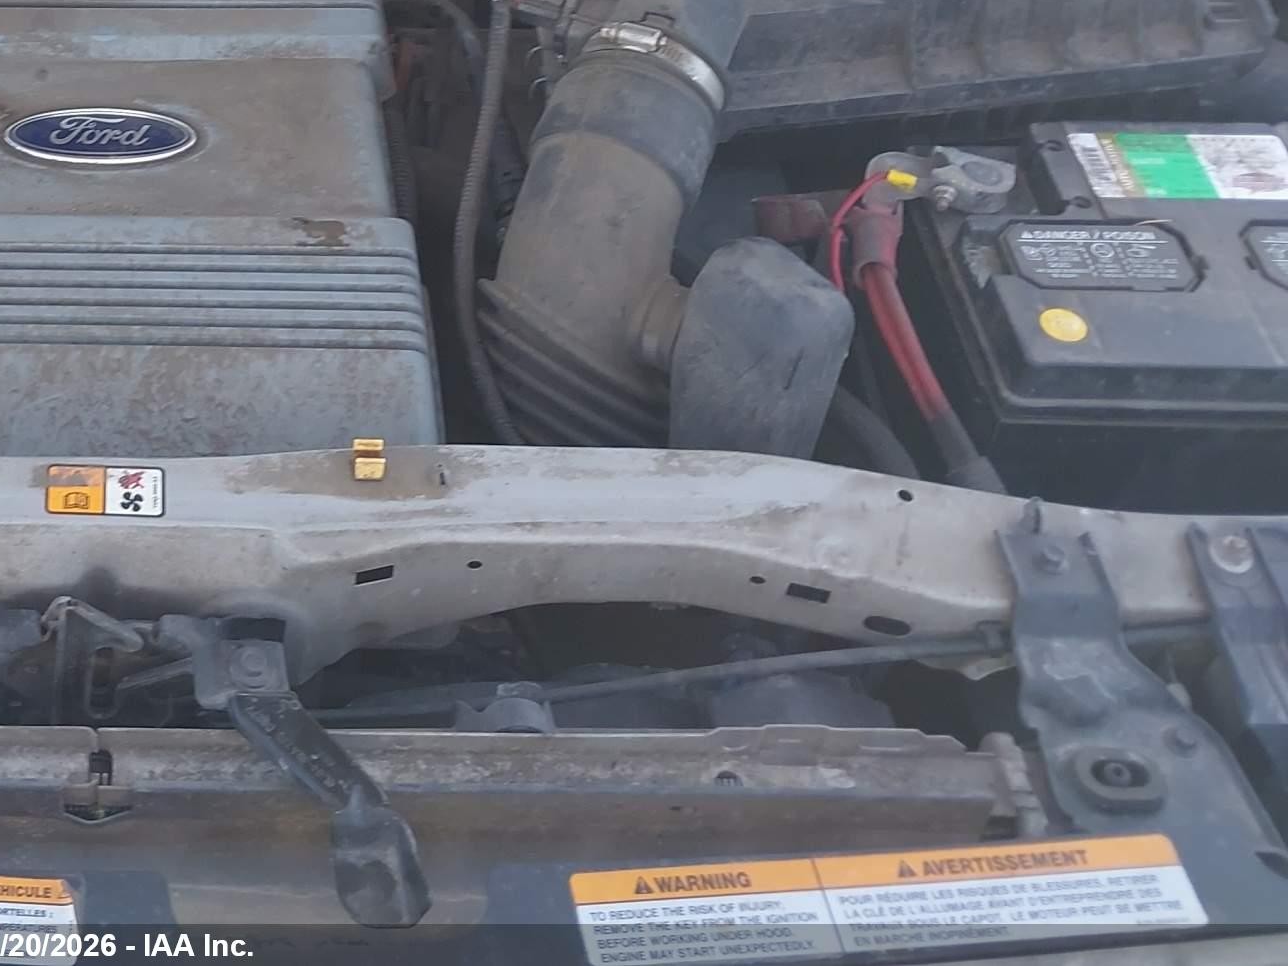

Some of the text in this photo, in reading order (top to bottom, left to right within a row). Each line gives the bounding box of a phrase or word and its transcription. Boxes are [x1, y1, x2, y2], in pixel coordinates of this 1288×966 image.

[50, 116, 152, 146] Ford
[923, 849, 1088, 876] AVERTISSEMENT
[655, 872, 751, 893] WARNING
[589, 912, 606, 921] TO
[611, 908, 658, 920] REDUCE
[662, 906, 685, 916] THE
[688, 904, 715, 915] RISK
[720, 903, 736, 913] OF
[593, 912, 818, 934] REMOVE THE KEY FROM THE IGNITION
[597, 938, 646, 949] BEFORE
[649, 933, 708, 946] WORKING
[712, 930, 754, 942] UNDER
[601, 951, 647, 963] ENGINE
[649, 949, 675, 960] MAY
[679, 946, 717, 958] START
